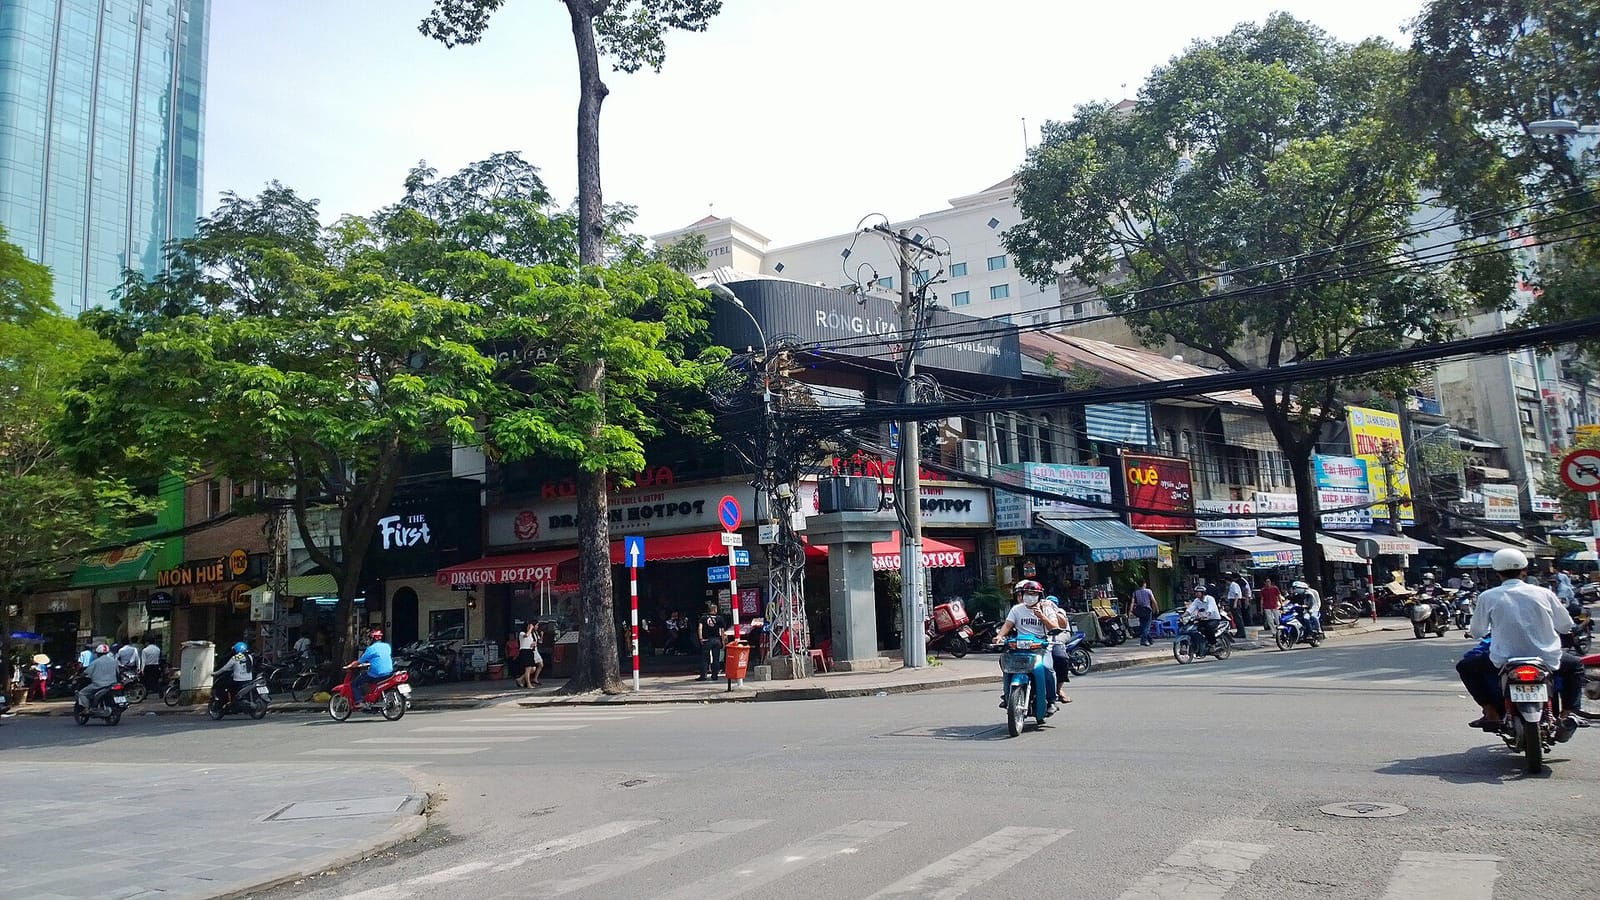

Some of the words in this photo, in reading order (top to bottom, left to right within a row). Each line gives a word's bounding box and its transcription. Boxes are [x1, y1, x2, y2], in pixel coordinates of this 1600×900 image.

[701, 246, 730, 258] HOTEL
[1091, 470, 1107, 480] 120
[627, 499, 706, 522] HOTPOT
[407, 514, 425, 524] THE
[377, 514, 432, 550] First
[920, 551, 961, 567] OTPOT
[451, 570, 497, 585] DRAGON
[500, 567, 553, 582] HOTPOT
